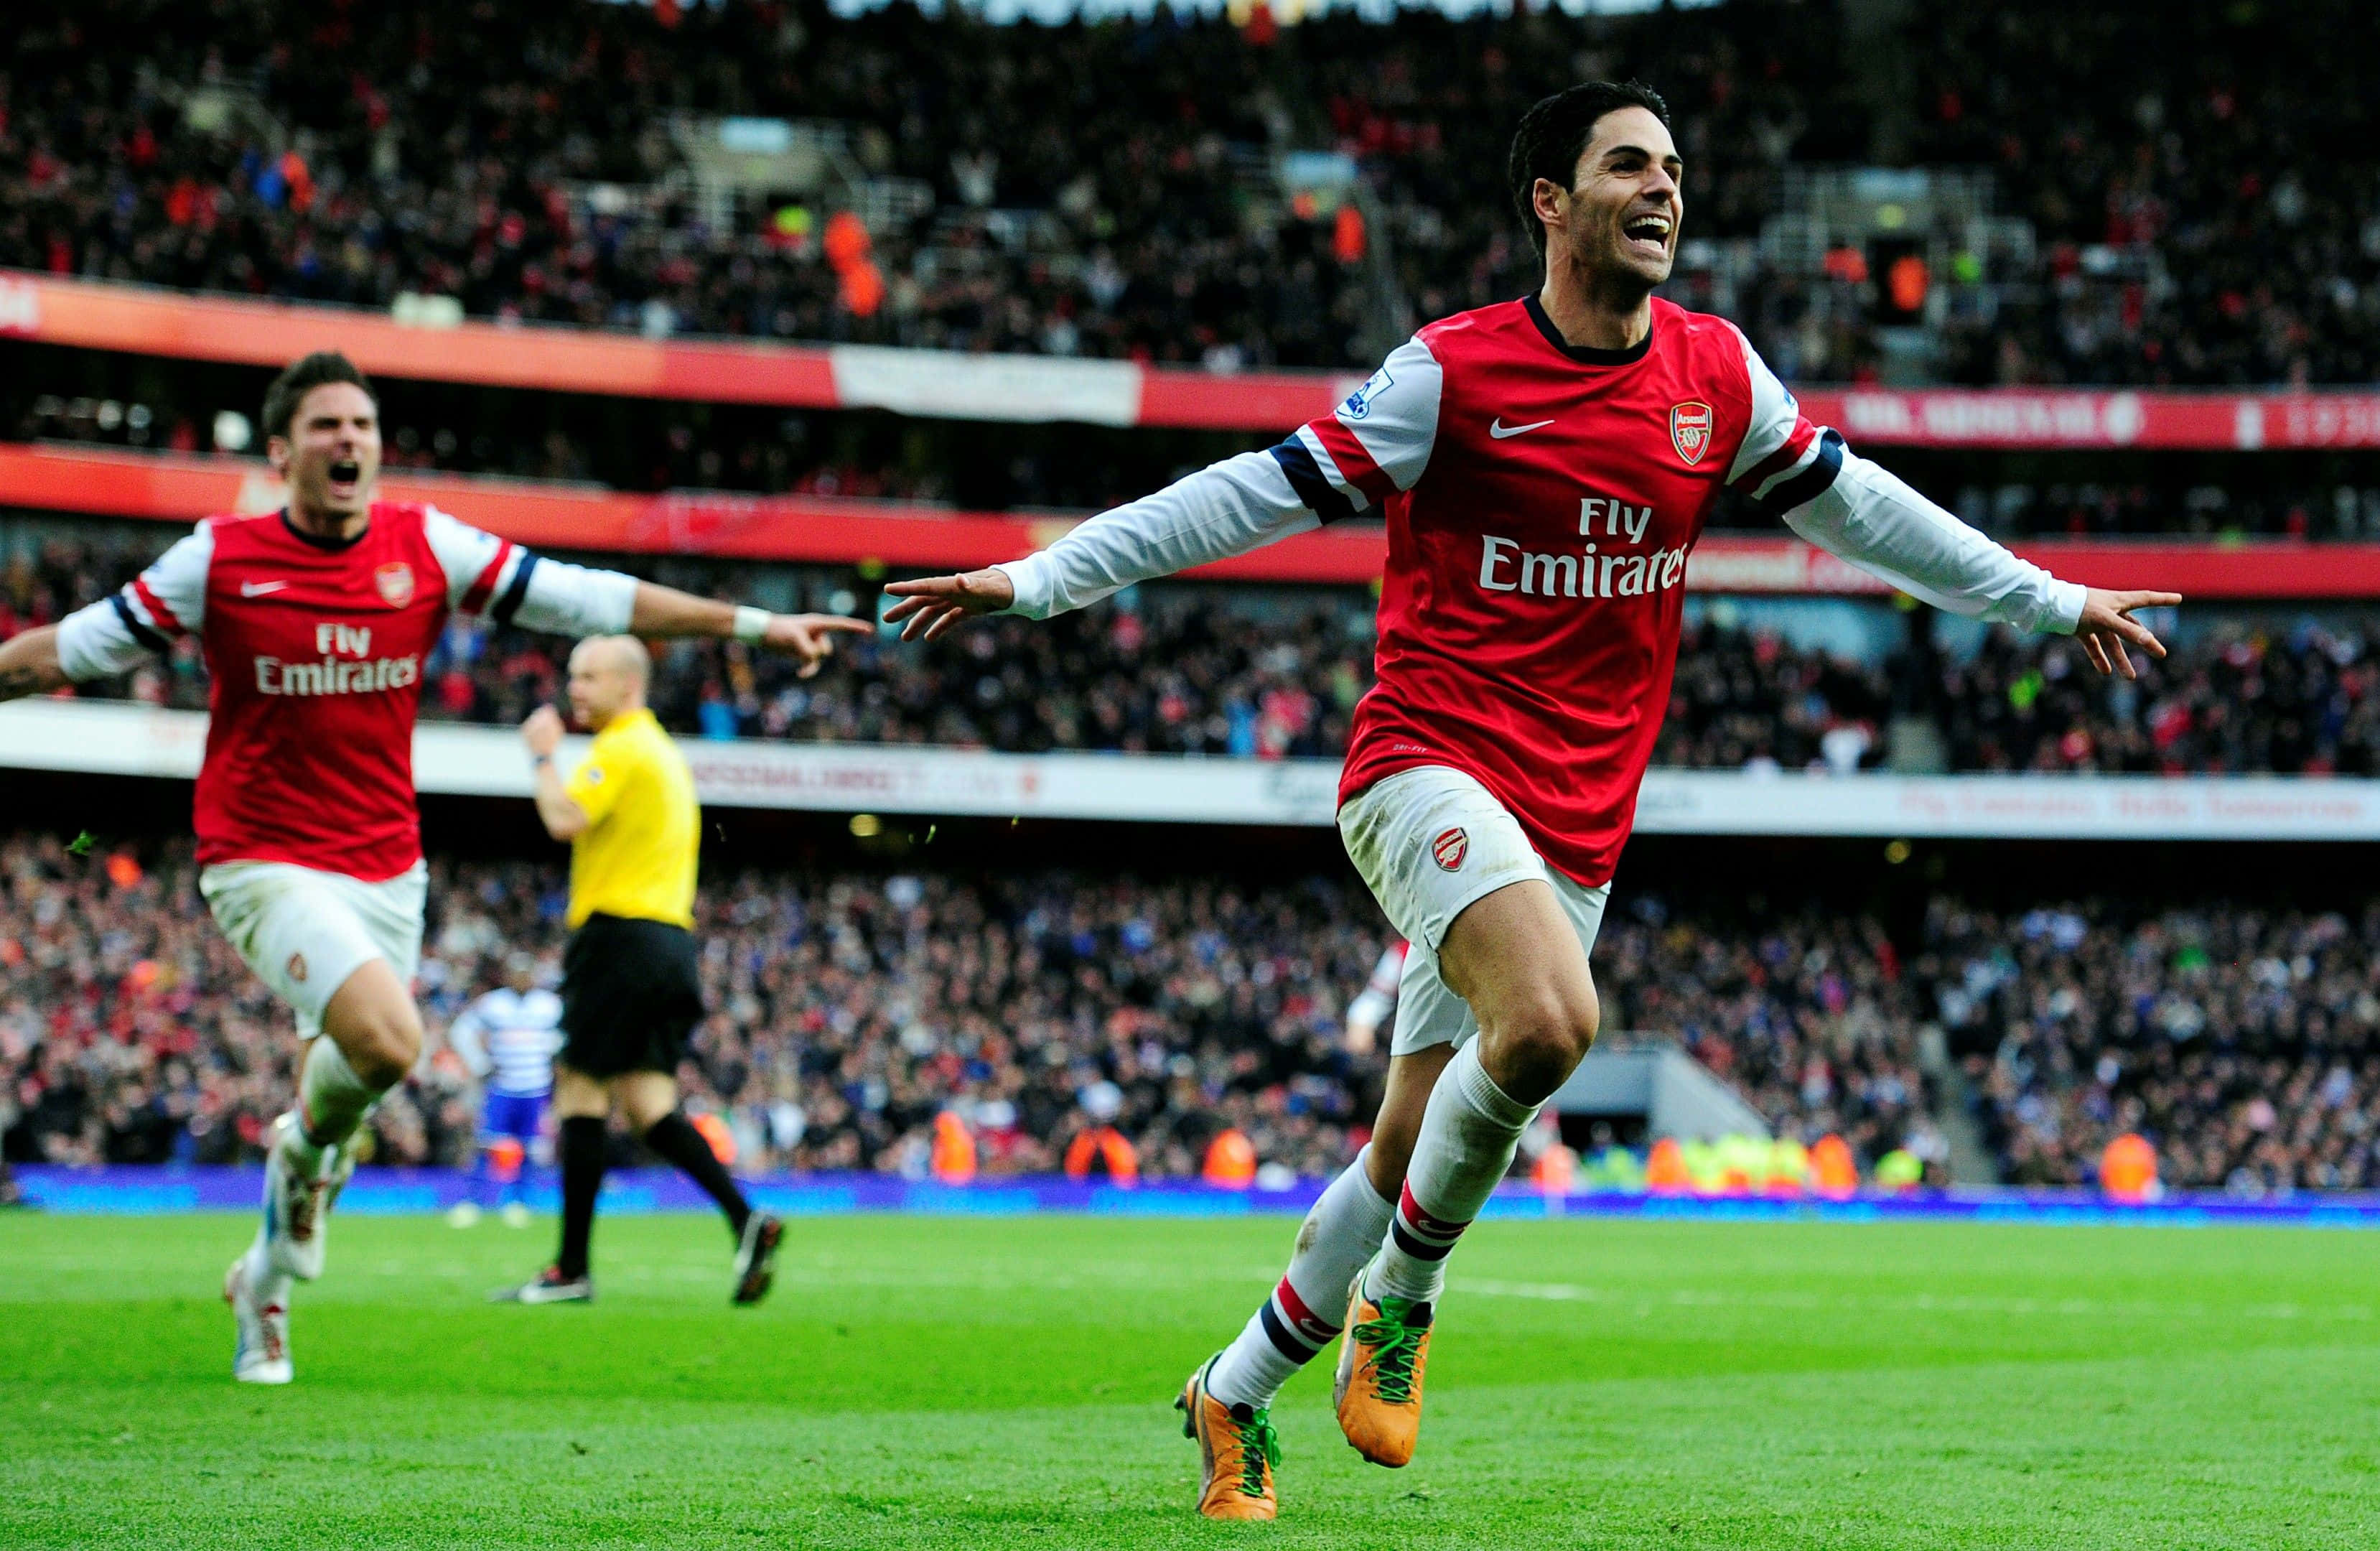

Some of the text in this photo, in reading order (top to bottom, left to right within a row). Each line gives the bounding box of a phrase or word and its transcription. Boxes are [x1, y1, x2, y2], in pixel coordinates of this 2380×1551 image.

[1677, 414, 1707, 424] Arsenal
[1579, 498, 1651, 544] Fly
[1480, 534, 1687, 597] Emirates
[316, 623, 371, 658] Fly
